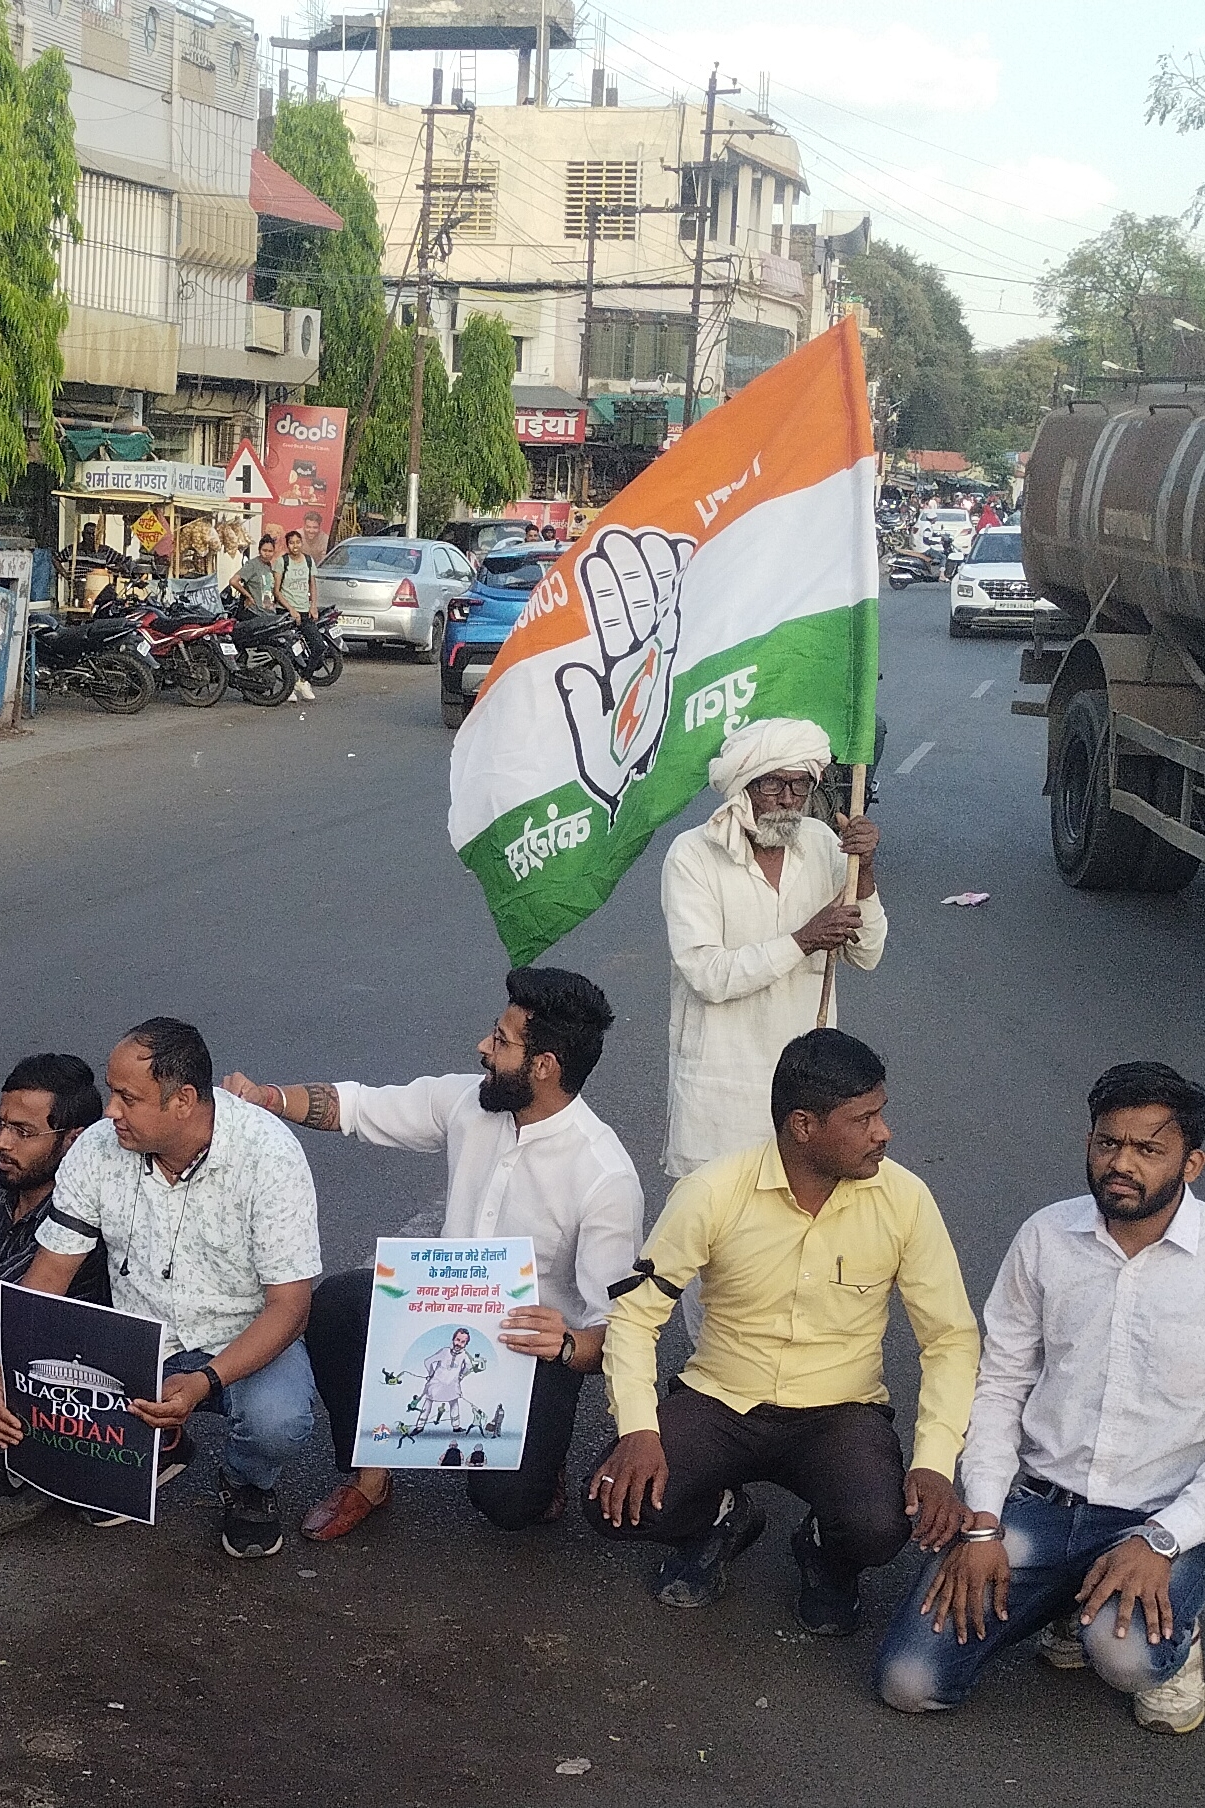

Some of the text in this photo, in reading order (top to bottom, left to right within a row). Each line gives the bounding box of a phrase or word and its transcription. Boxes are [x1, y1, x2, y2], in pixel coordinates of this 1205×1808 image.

[276, 413, 338, 442] drools
[85, 466, 110, 489] शर्मा
[112, 473, 132, 489] चाट
[134, 473, 168, 490] भण्डार
[178, 469, 194, 490] शर्मा
[194, 475, 206, 492] चाट
[417, 1286, 440, 1296] मगर
[51, 1399, 94, 1423] FOR
